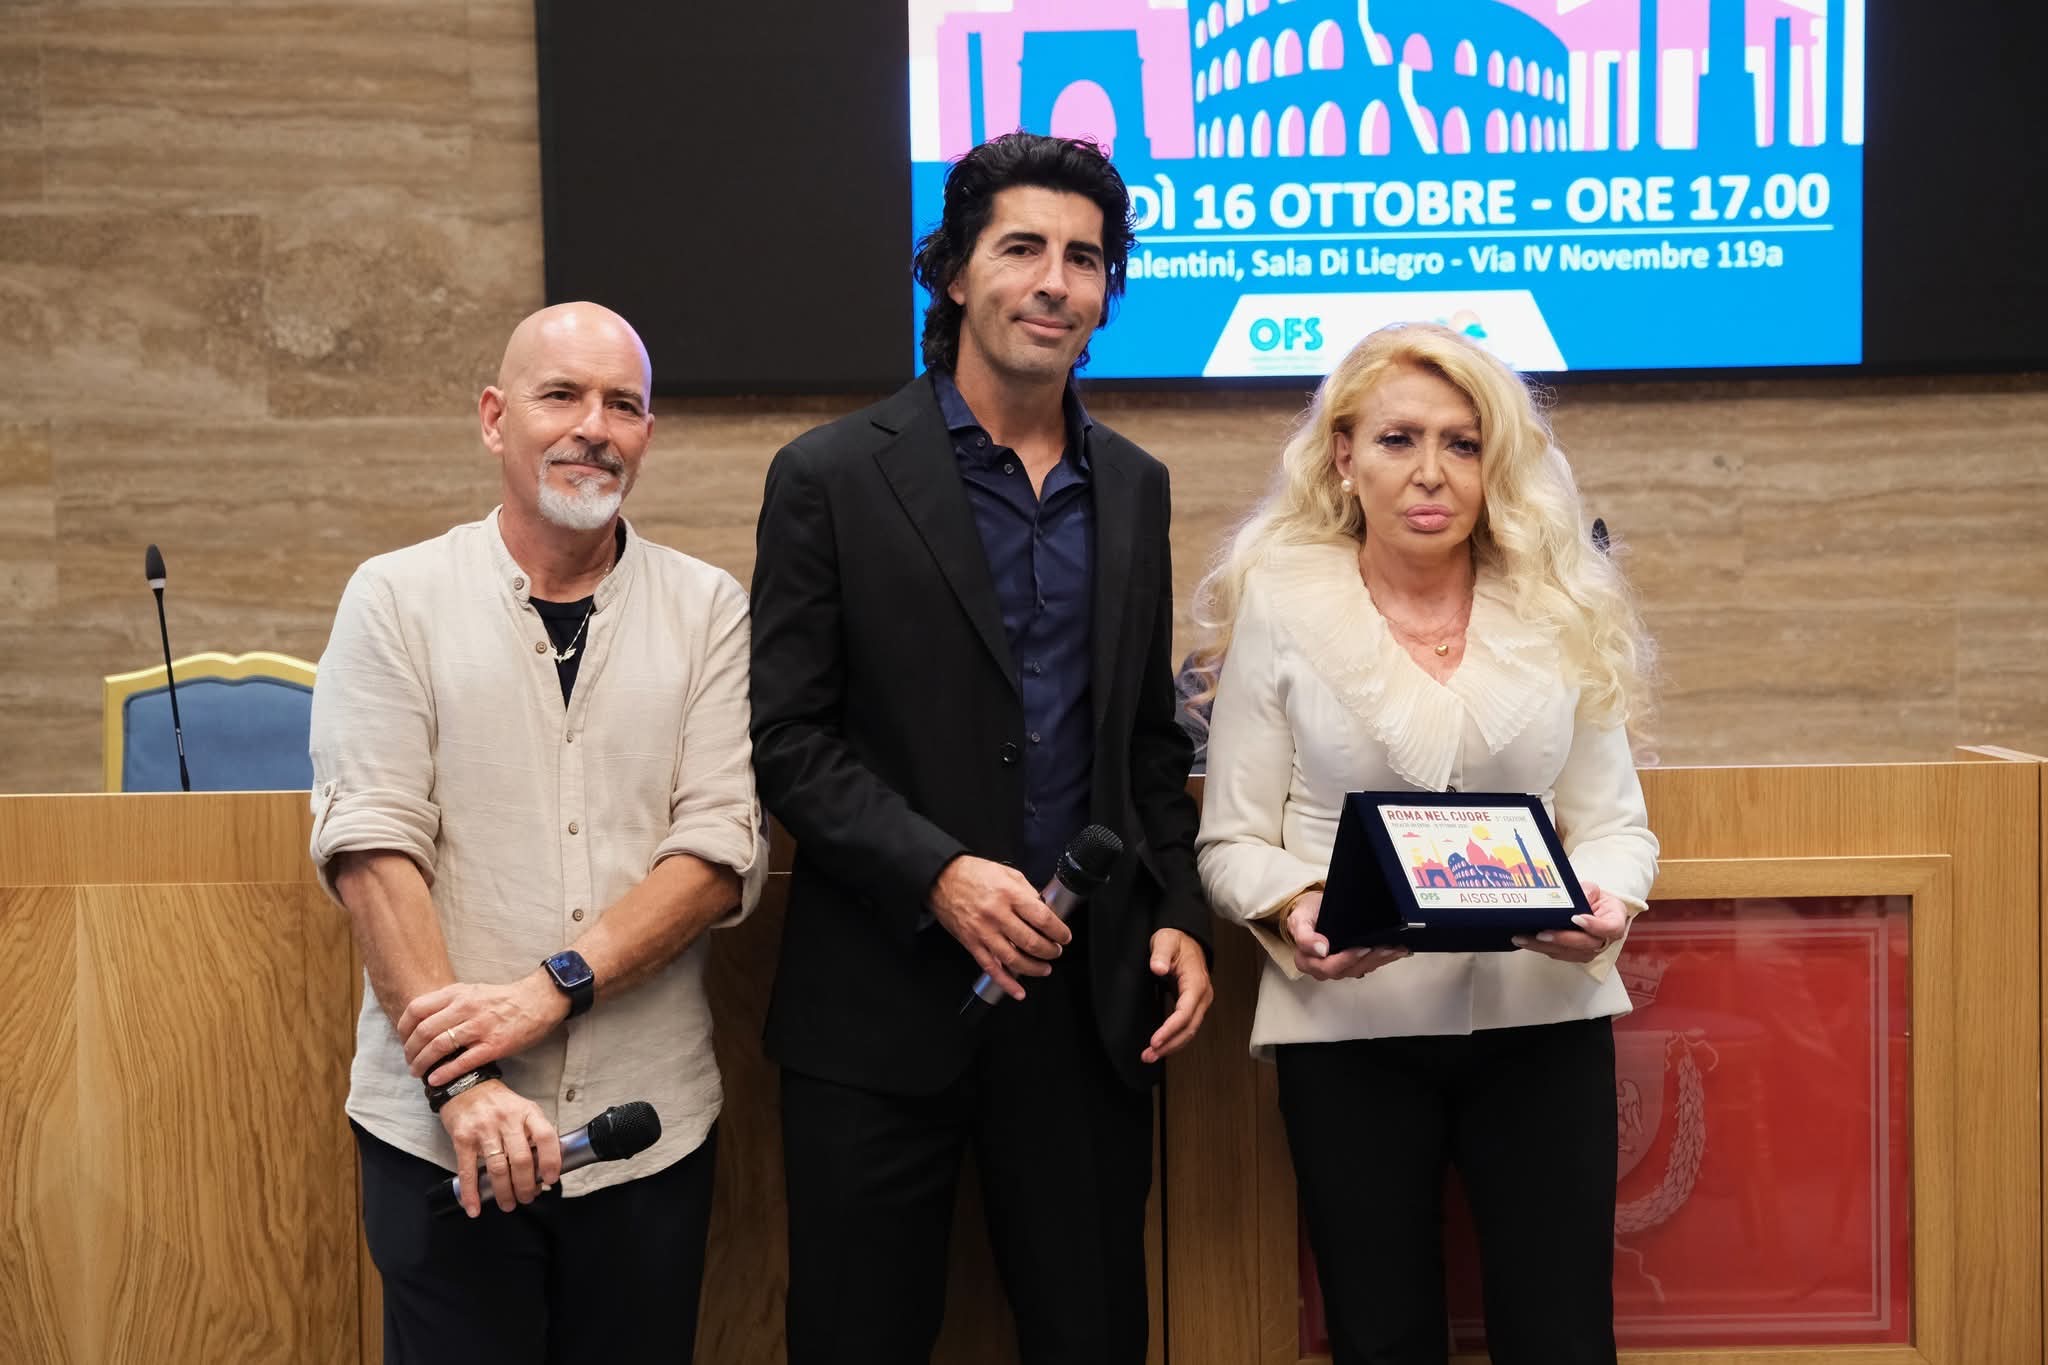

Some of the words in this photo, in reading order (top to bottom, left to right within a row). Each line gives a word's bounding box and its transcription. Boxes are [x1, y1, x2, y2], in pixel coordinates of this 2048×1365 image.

[1127, 173, 1176, 231] DÌ
[1192, 184, 1257, 229] 16
[1269, 179, 1517, 229] OTTOBRE
[1530, 197, 1553, 211] -
[1565, 177, 1675, 224] ORE
[1690, 172, 1831, 221] 17.00
[1125, 249, 1244, 281] alentini,
[1251, 248, 1313, 277] Sala
[1319, 247, 1349, 276] Di
[1356, 246, 1445, 281] Liegro
[1450, 257, 1464, 267] -
[1468, 245, 1516, 274] Via
[1523, 244, 1554, 273] IV
[1559, 240, 1709, 271] Novembre
[1716, 239, 1784, 269] 119a
[1249, 317, 1323, 351] OFS
[1386, 810, 1423, 821] ROMA
[1424, 810, 1450, 821] NEL
[1450, 810, 1492, 822] CUORE
[1458, 892, 1499, 904] AISOS
